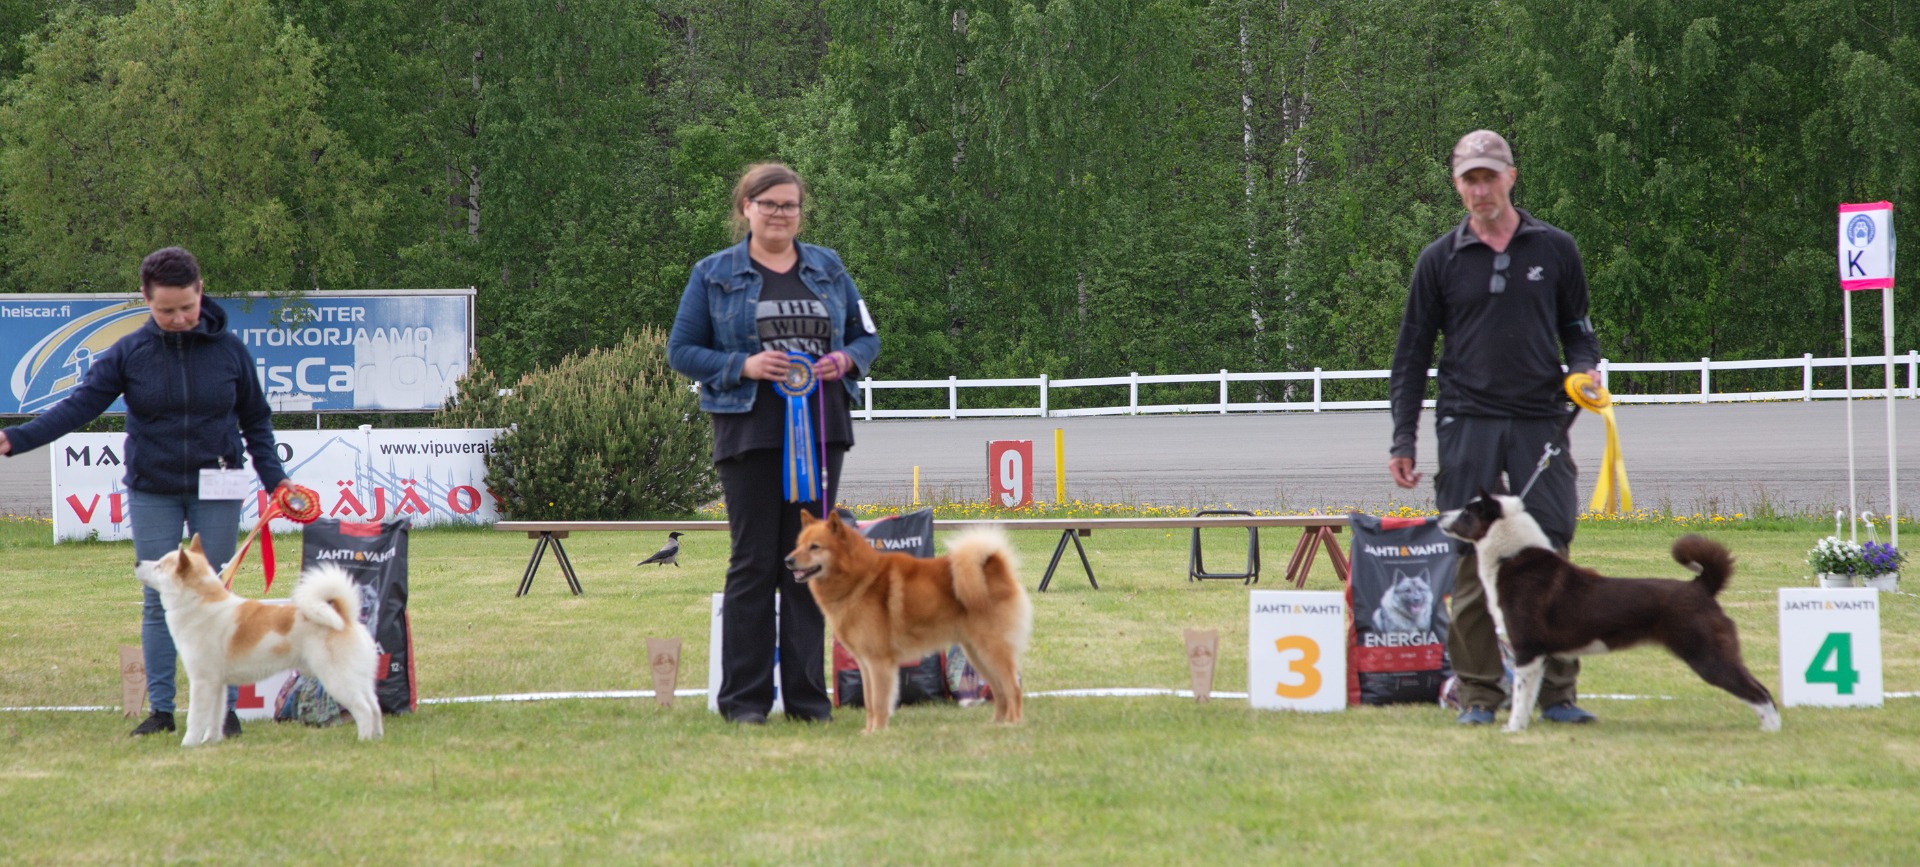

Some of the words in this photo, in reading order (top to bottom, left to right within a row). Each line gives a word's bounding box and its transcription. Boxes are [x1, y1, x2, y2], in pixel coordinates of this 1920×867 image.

[1848, 250, 1867, 277] K
[1, 304, 71, 318] heiscar.fi
[280, 306, 366, 323] CENTER
[772, 300, 821, 316] THE
[232, 327, 433, 346] UTOKORJAAMO
[1000, 449, 1022, 508] 9
[1364, 631, 1440, 648] ENERGIA
[1274, 634, 1323, 700] 3
[1804, 631, 1860, 695] 4
